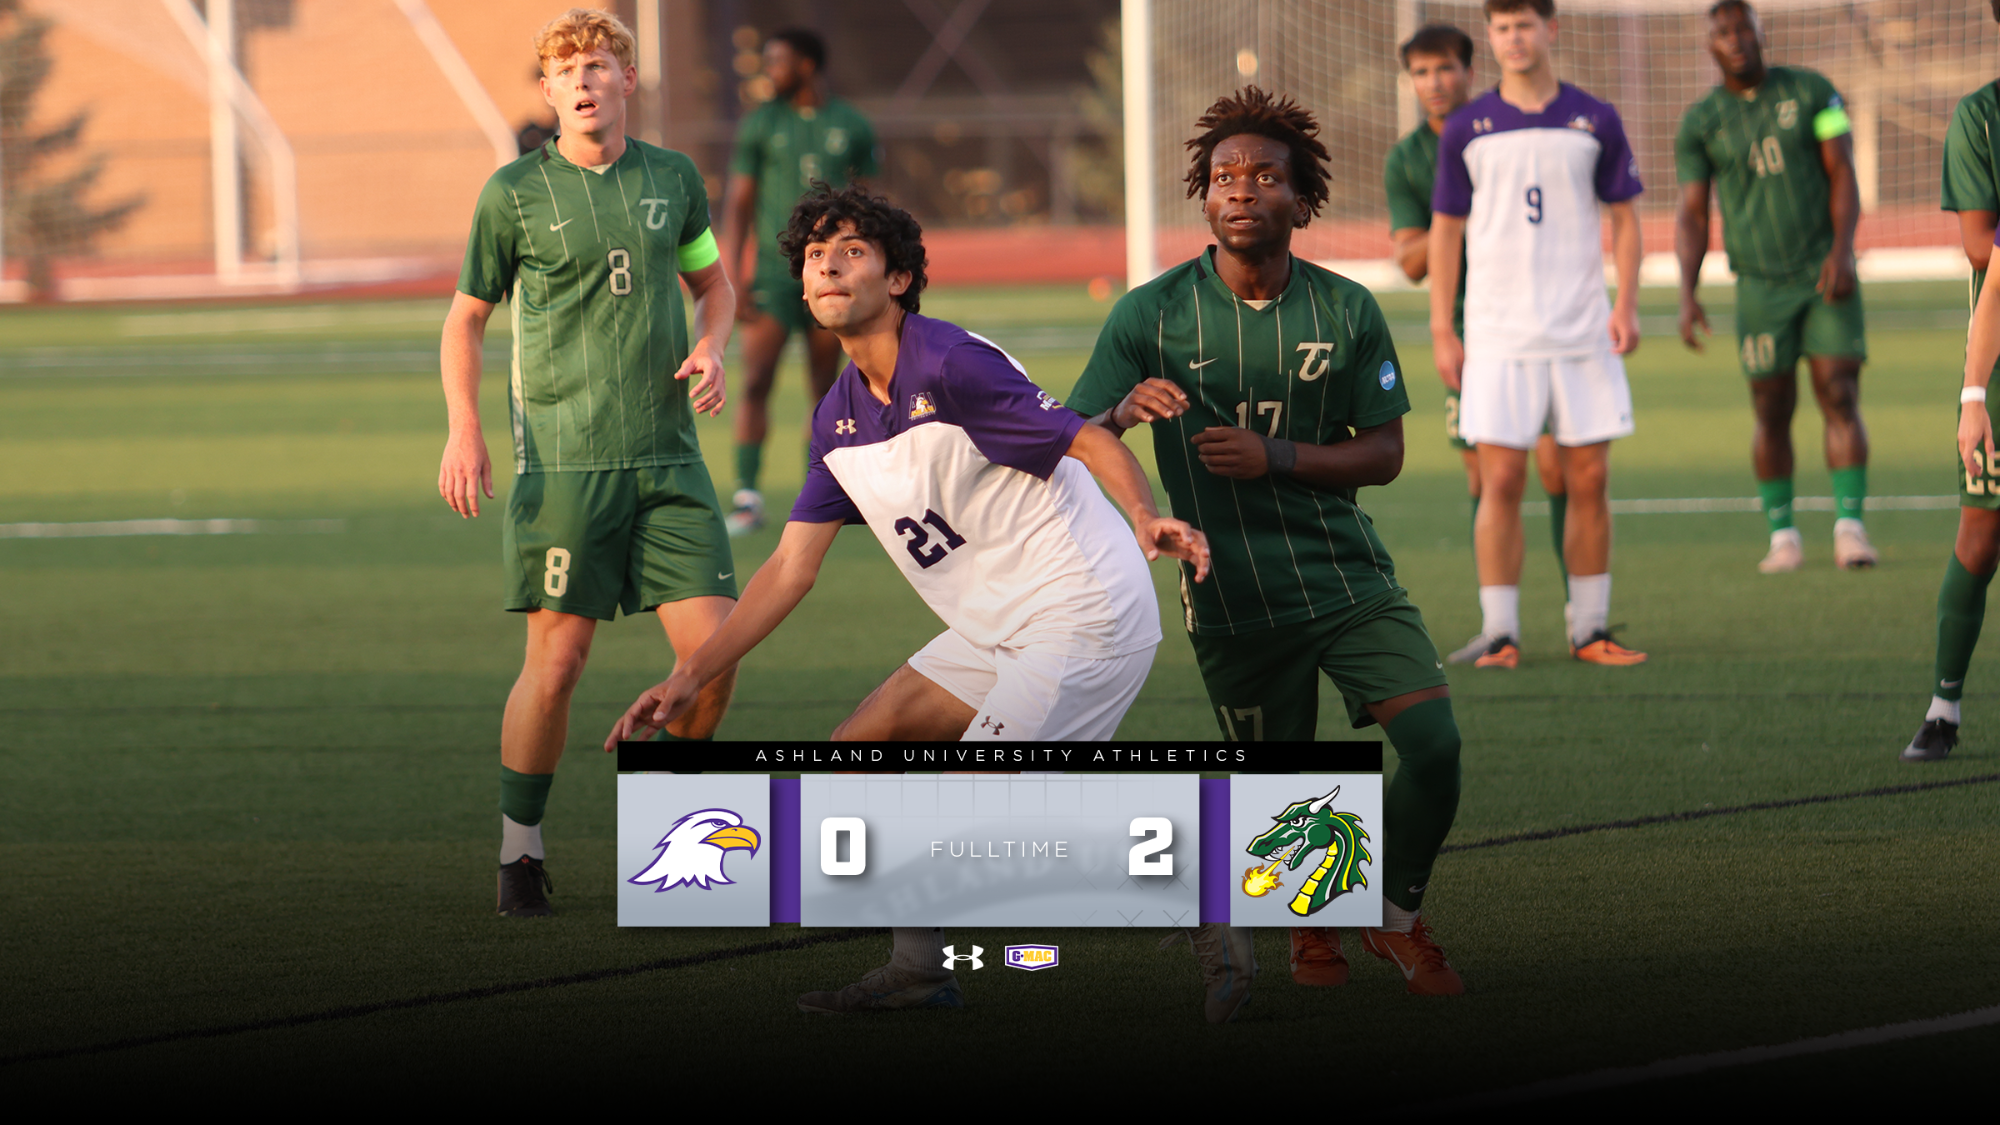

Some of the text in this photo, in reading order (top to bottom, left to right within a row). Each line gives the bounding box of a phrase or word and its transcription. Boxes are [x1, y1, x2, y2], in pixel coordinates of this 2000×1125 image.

[1747, 135, 1785, 179] 40
[1526, 187, 1542, 224] 9
[606, 247, 632, 296] 8
[1742, 332, 1776, 372] 40
[1235, 400, 1283, 439] 17
[894, 508, 967, 570] 21
[543, 546, 571, 598] 8
[1219, 704, 1264, 742] 17
